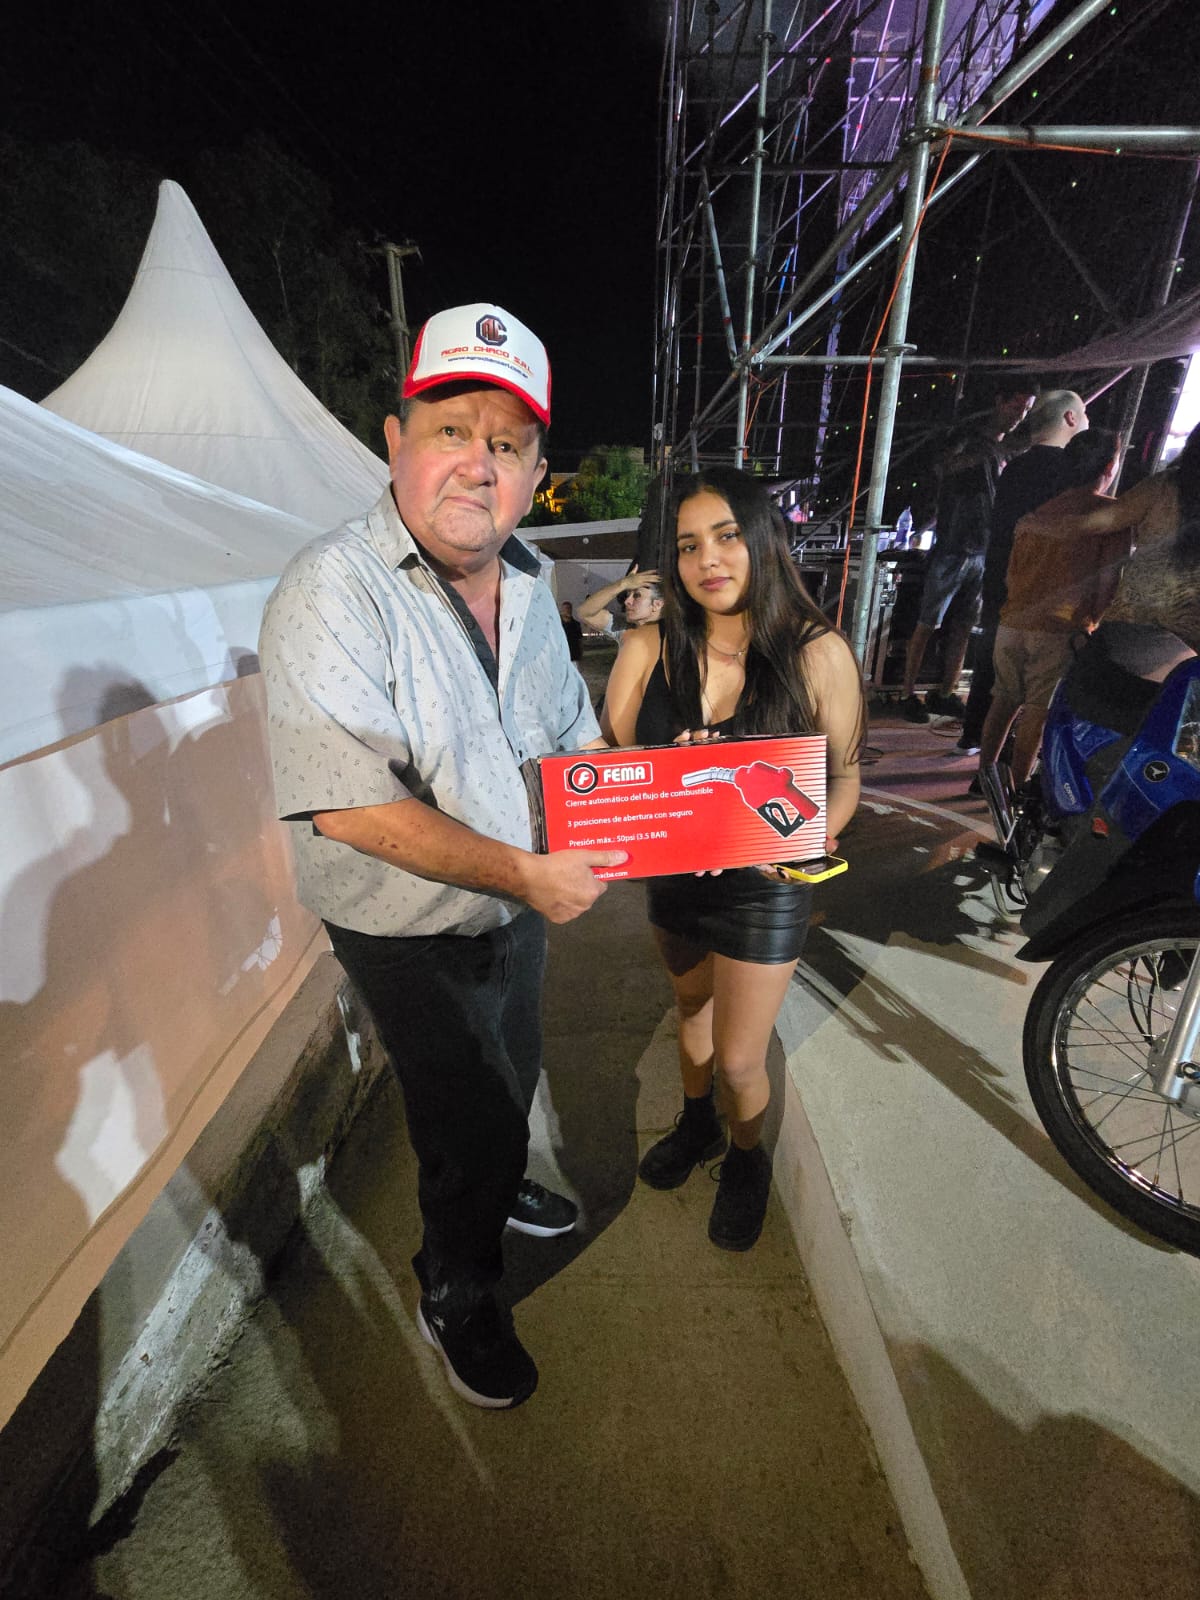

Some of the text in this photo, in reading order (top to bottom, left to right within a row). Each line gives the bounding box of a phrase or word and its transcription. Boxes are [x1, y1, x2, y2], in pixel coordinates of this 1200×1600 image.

[441, 346, 468, 356] AGRO
[474, 346, 510, 358] CHACO
[603, 766, 646, 783] FEMA
[565, 787, 714, 808] Cierre automático del flujo de combustible
[567, 820, 572, 828] 3
[573, 817, 611, 828] posiciones
[612, 815, 622, 823] de
[623, 813, 653, 822] abertura
[669, 810, 694, 819] seguro
[569, 838, 595, 847] Presión
[616, 834, 635, 844] 50psi
[636, 832, 650, 841] (3.5
[650, 830, 668, 840] BAR)
[594, 870, 628, 879] macba.com
